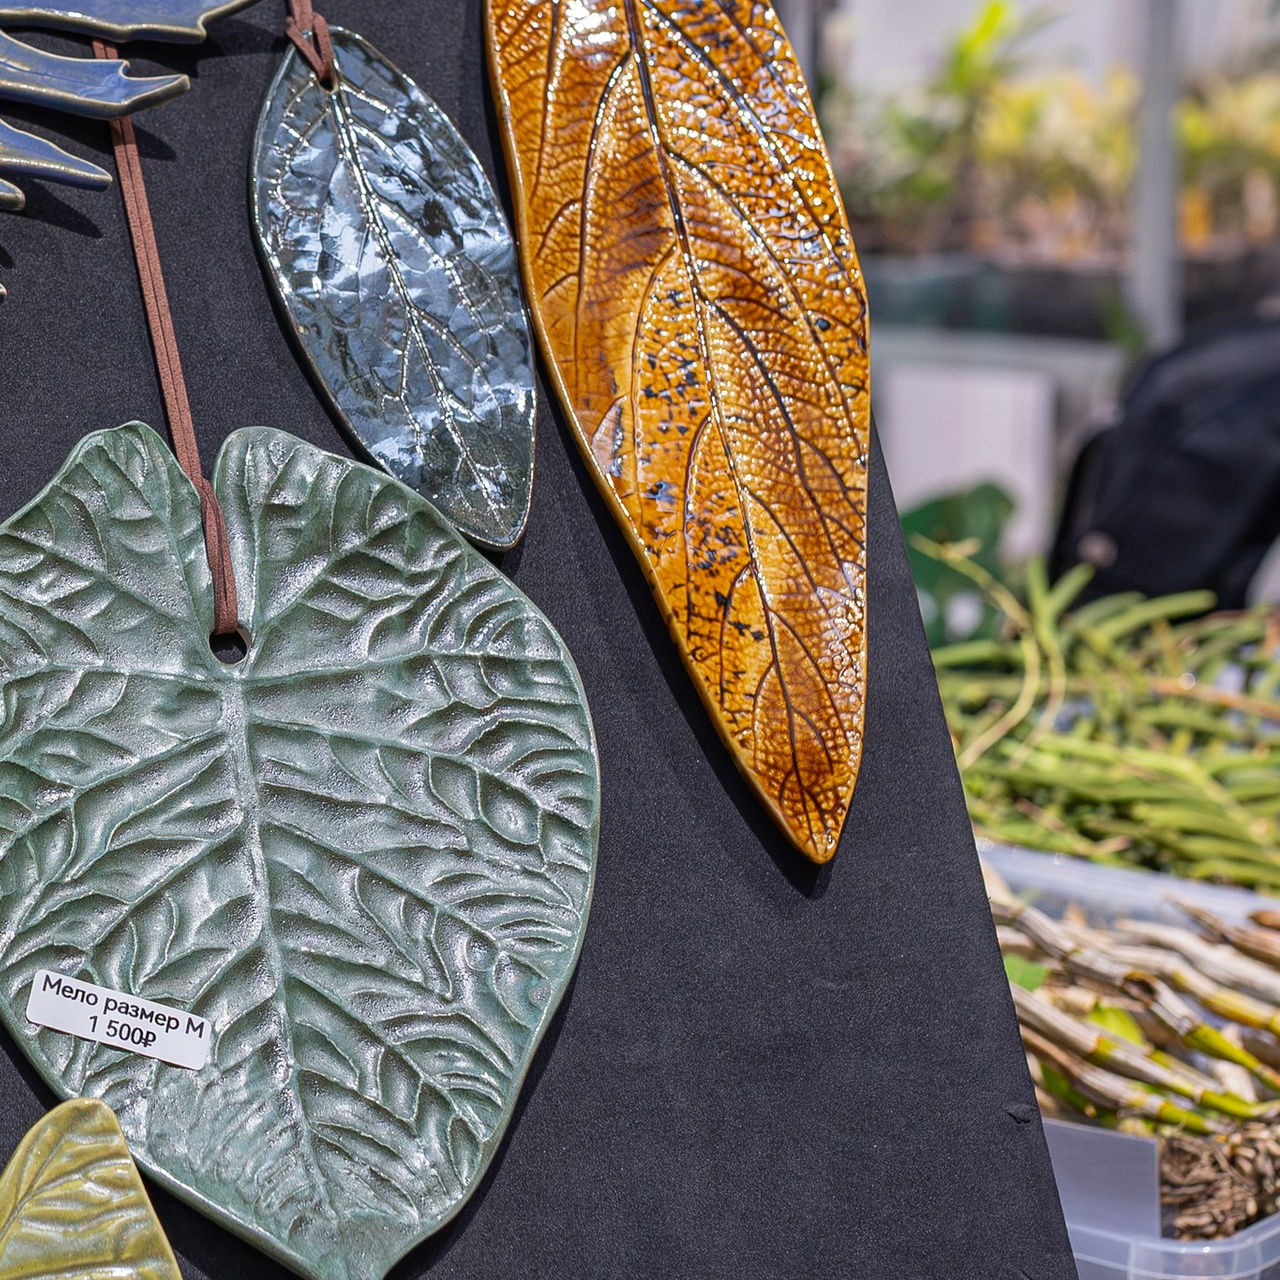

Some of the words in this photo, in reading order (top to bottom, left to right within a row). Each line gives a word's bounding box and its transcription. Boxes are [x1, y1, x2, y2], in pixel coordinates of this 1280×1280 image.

[42, 974, 98, 1006] Мело
[103, 996, 180, 1033] размер
[89, 1015, 98, 1032] 1
[106, 1019, 156, 1047] 500₽
